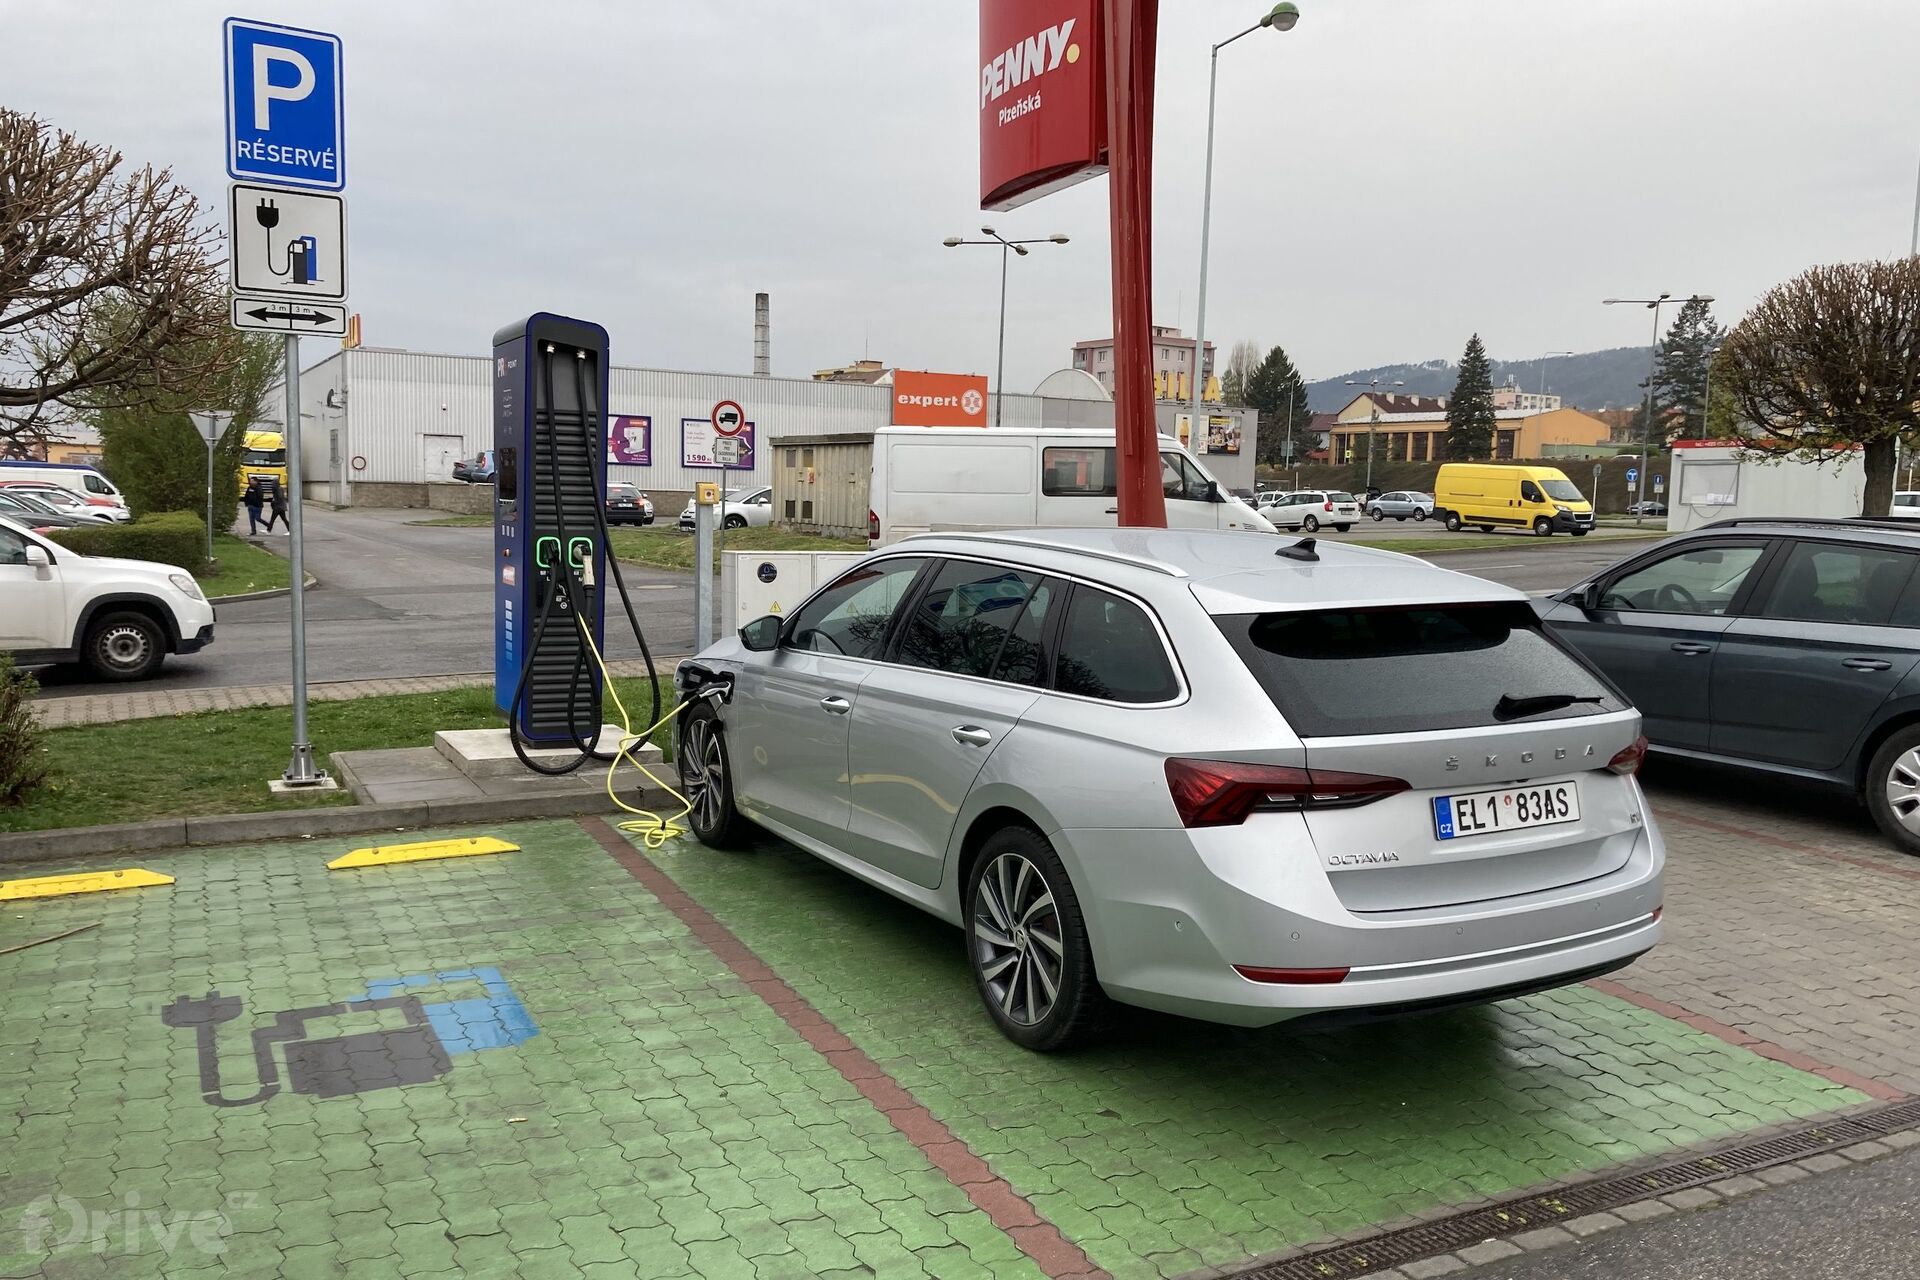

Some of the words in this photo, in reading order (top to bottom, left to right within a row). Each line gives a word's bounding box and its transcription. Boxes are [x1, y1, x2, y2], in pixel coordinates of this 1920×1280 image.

[252, 42, 316, 131] P
[998, 89, 1041, 127] Plzeňská
[237, 137, 335, 170] RÉSERVÉ
[271, 303, 276, 311] 3
[897, 393, 958, 408] expert
[1445, 743, 1595, 772] ŠKODA
[1456, 796, 1499, 832] EL1
[1515, 787, 1569, 823] 83AS
[1440, 822, 1452, 834] CZ
[1328, 851, 1400, 866] OCTAVIA
